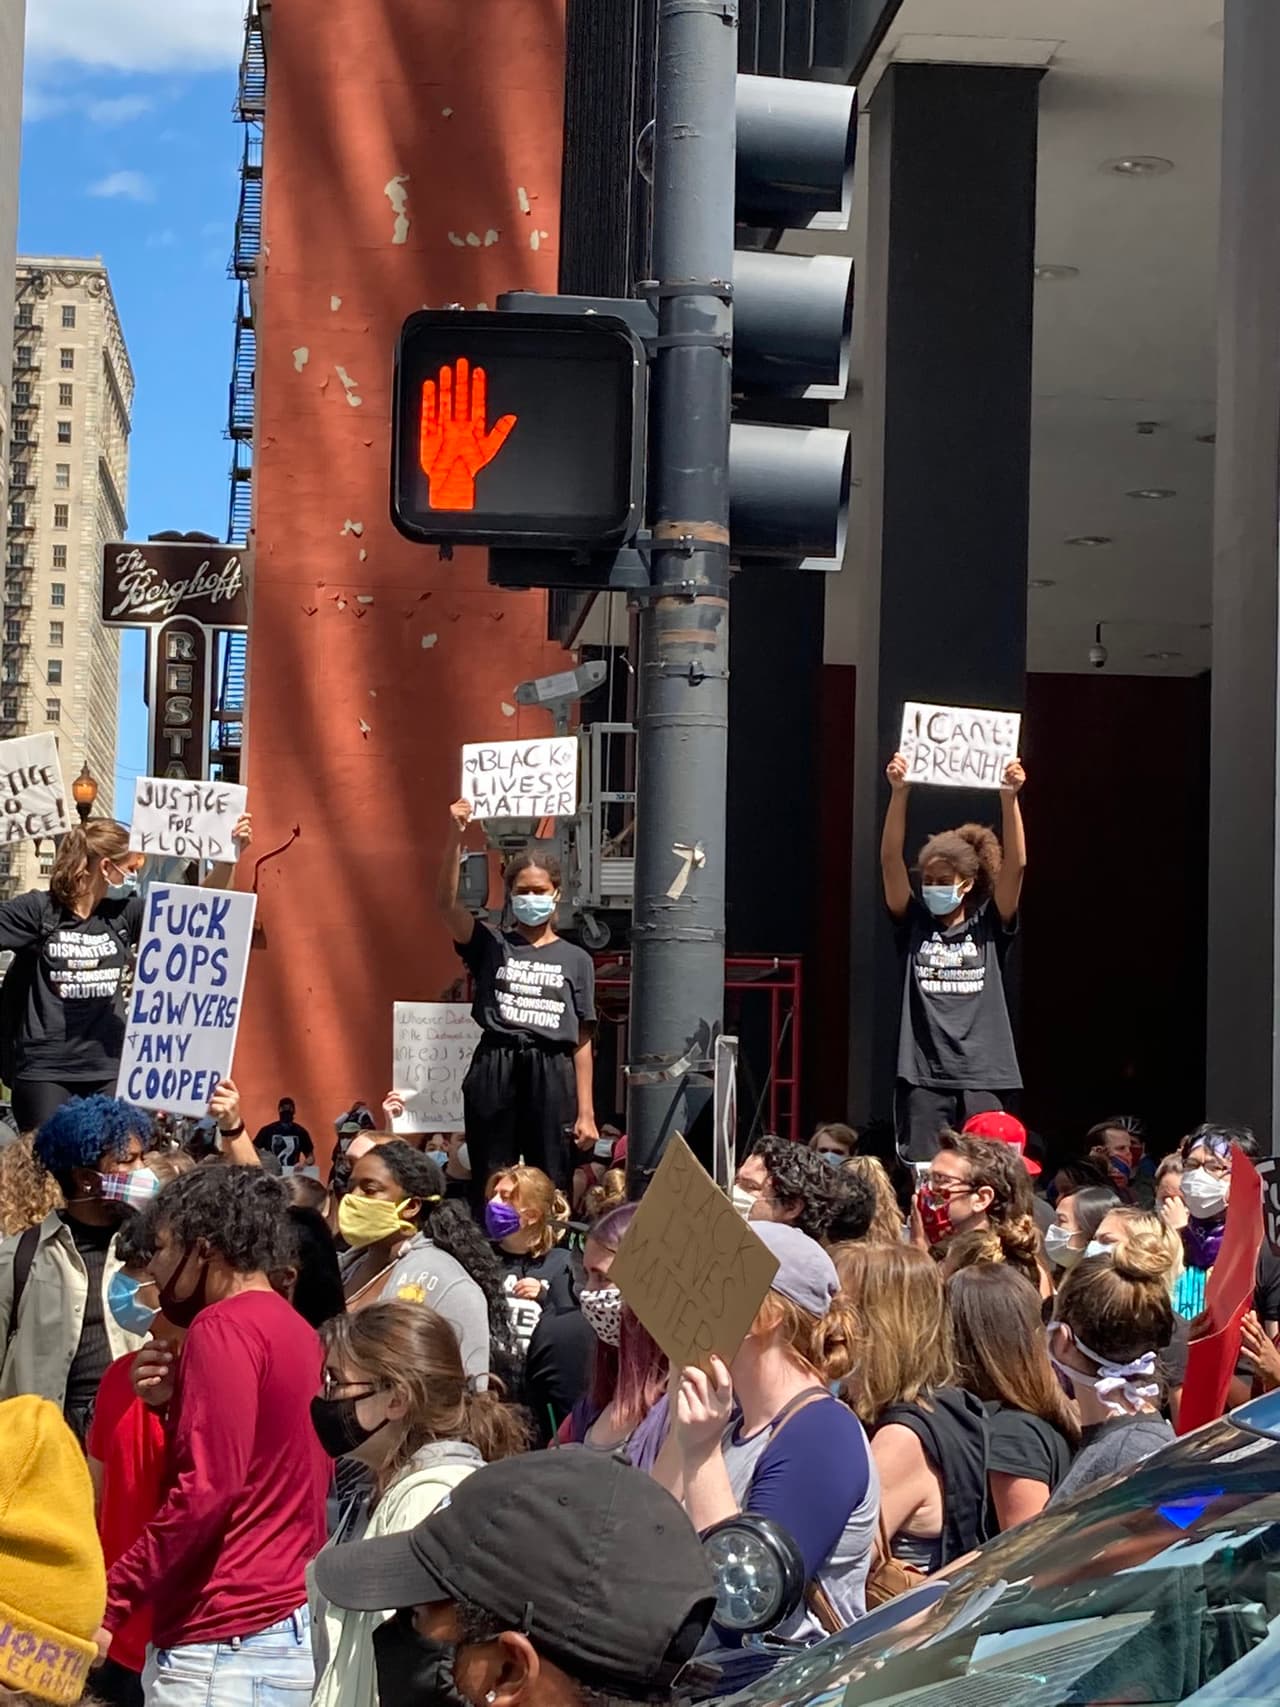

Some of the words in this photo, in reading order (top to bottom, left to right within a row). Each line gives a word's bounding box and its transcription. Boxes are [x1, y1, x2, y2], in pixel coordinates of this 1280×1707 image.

[116, 548, 148, 573] The
[110, 556, 242, 616] Berghoff
[915, 710, 922, 739] I
[478, 745, 563, 778] BLACK
[0, 764, 56, 796] TICE
[472, 773, 553, 797] LIVES
[137, 781, 231, 814] JUSTICE
[473, 791, 572, 817] MATTER
[5, 799, 66, 841] ACE!
[168, 813, 195, 834] FOR
[142, 832, 222, 858] FLOYD
[49, 940, 118, 958] DISPARITIES
[138, 938, 229, 986] COPS
[137, 1033, 192, 1063] AMY
